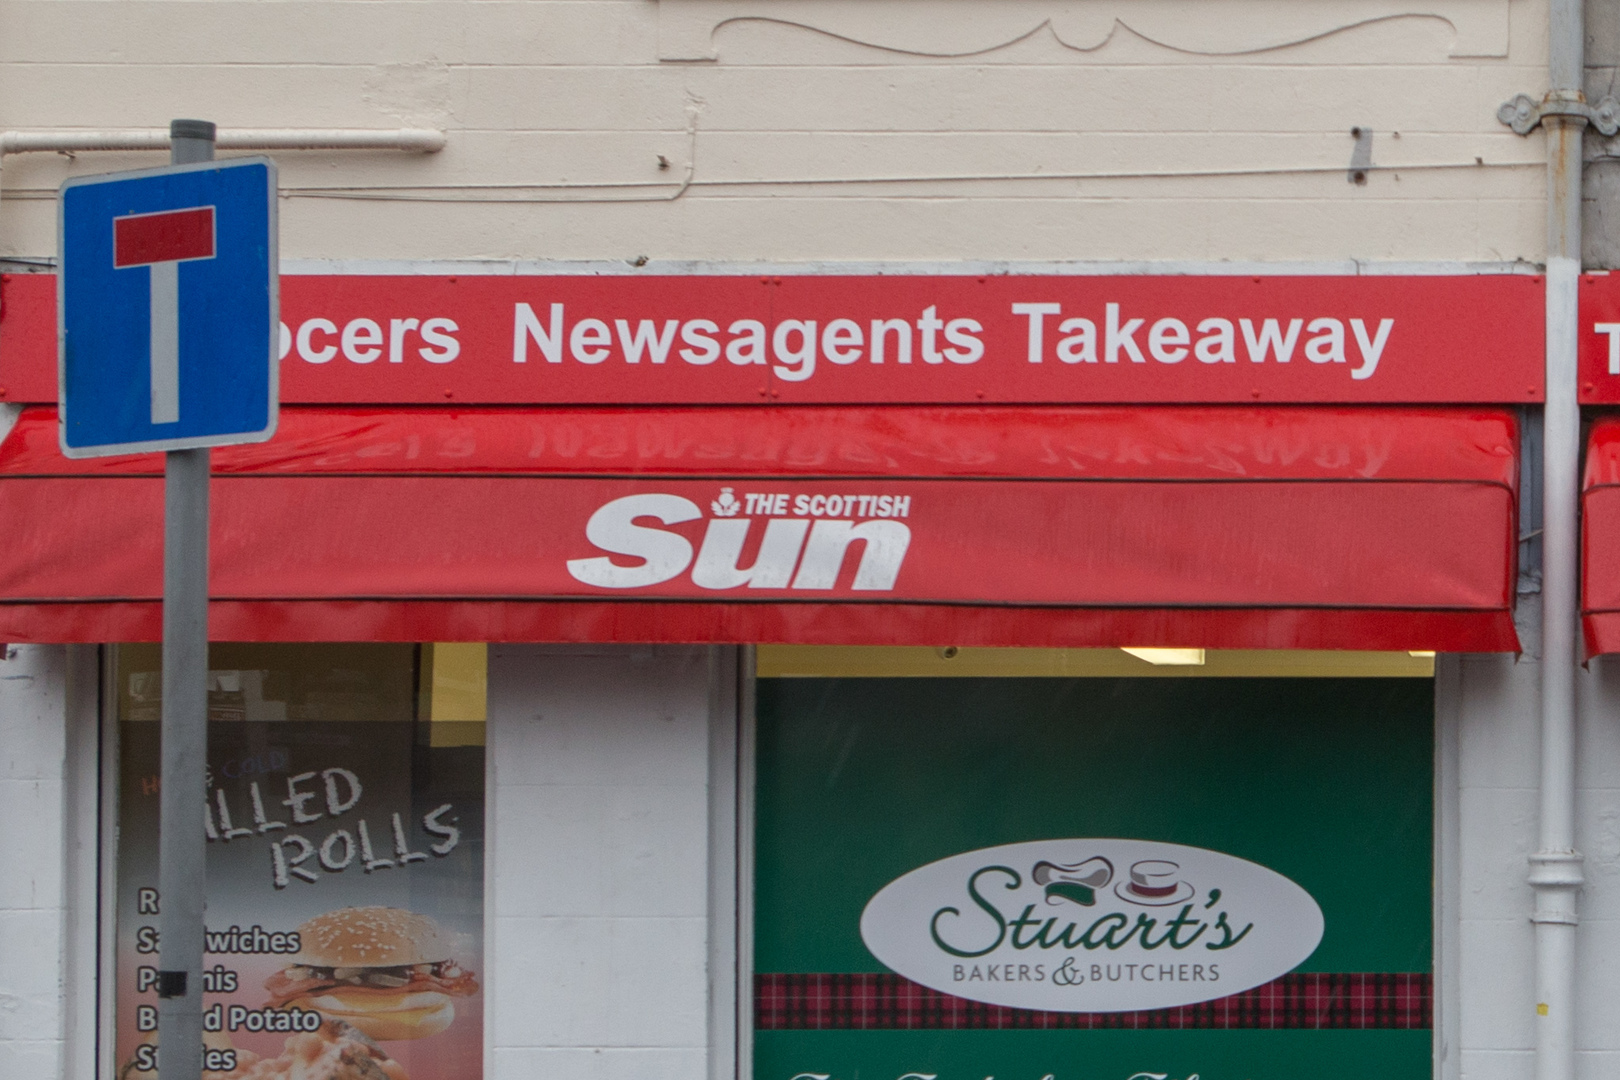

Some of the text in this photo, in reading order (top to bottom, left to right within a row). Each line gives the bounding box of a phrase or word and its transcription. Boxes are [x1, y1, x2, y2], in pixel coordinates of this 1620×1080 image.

[512, 302, 985, 382] Newsagents
[1011, 302, 1395, 380] Takeaway
[745, 492, 911, 518] THE SCOTTISH
[205, 768, 363, 840] ILLED
[272, 803, 461, 886] ROLLS
[930, 865, 1254, 958] Stuart's
[138, 926, 300, 953] Swiches
[138, 966, 237, 991] Pnis
[953, 956, 1220, 985] BAKERS & BUTCHERS
[230, 1006, 321, 1032] Potato
